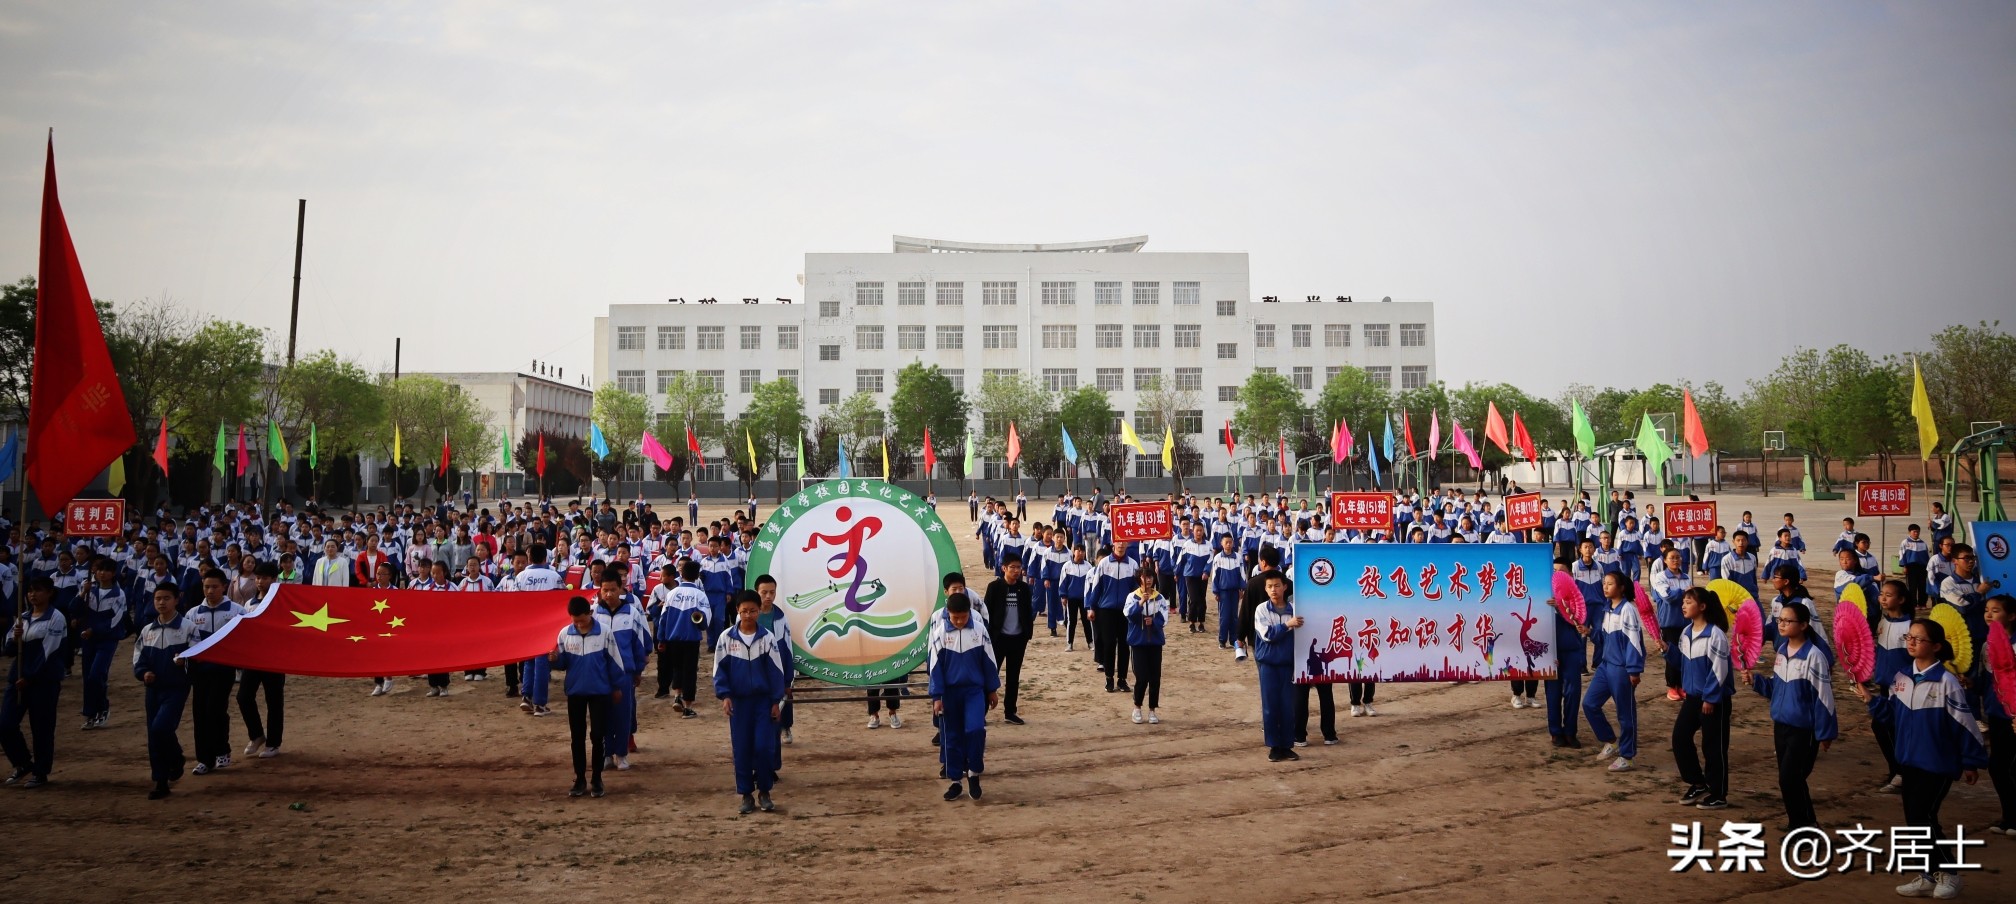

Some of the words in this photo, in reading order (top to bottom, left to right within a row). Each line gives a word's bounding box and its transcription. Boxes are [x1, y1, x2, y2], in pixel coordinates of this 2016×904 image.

[1863, 488, 1906, 502] 八年级(5)班
[73, 507, 115, 521] 裁判员
[1339, 500, 1387, 514] 九年级(5)班
[1117, 510, 1166, 526] 九年级(3)班
[1669, 508, 1712, 523] 八年级(3)班
[76, 523, 111, 531] 代表队
[1124, 527, 1160, 536] 代表队
[1675, 524, 1707, 532] 代表队
[526, 576, 548, 586] Sport
[1357, 561, 1529, 603] 放飞艺术梦想
[1325, 613, 1497, 653] 展示知识才华
[842, 671, 863, 680] Xiao
[865, 668, 888, 680] Yuan
